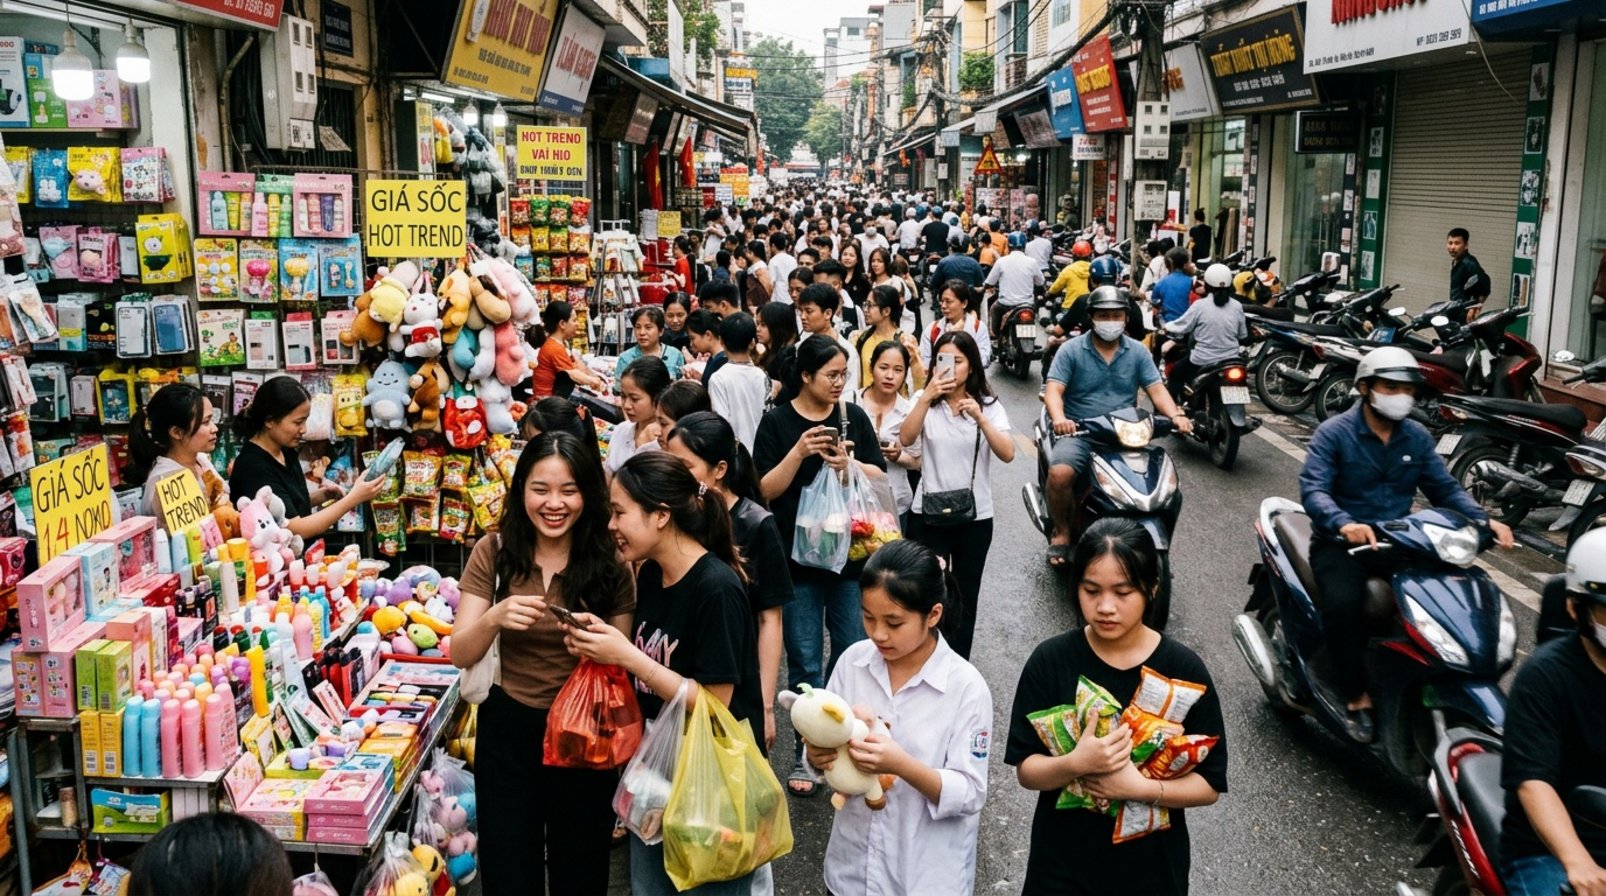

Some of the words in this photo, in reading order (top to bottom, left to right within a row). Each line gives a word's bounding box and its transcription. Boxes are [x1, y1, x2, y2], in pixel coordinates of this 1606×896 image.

[521, 131, 542, 142] HOT
[371, 184, 411, 212] GIÁ
[417, 182, 462, 213] SỐC
[369, 224, 404, 247] HOT
[407, 224, 463, 247] TREND
[72, 450, 105, 500] SỐC
[161, 474, 185, 505] HOT
[166, 495, 206, 531] TREND
